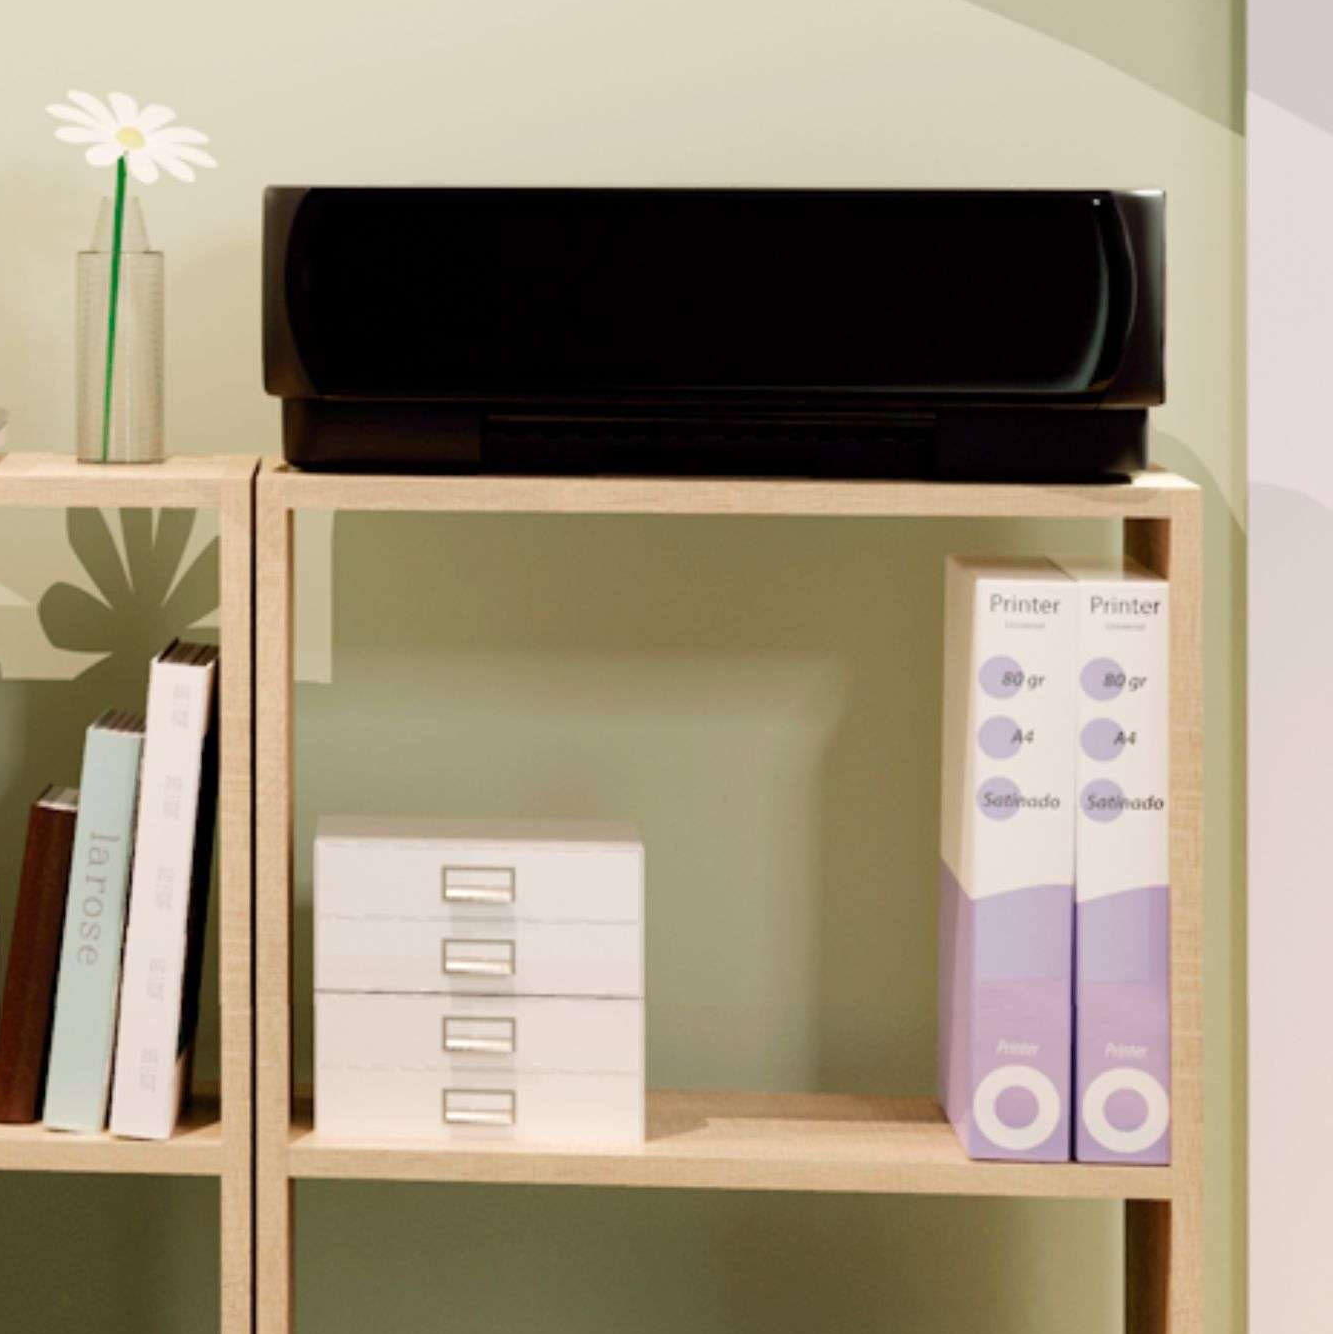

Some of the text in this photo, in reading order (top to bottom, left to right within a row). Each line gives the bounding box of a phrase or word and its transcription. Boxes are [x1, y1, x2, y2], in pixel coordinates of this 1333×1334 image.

[989, 593, 1061, 614] Printer
[1089, 595, 1161, 615] Printer
[1001, 671, 1046, 692] 80 gr
[1102, 672, 1147, 692] 80 gr
[1012, 729, 1034, 744] A4
[1113, 731, 1137, 745] A4
[982, 792, 1061, 809] Satinado
[1086, 793, 1165, 811] Satinado
[77, 830, 120, 967] larose
